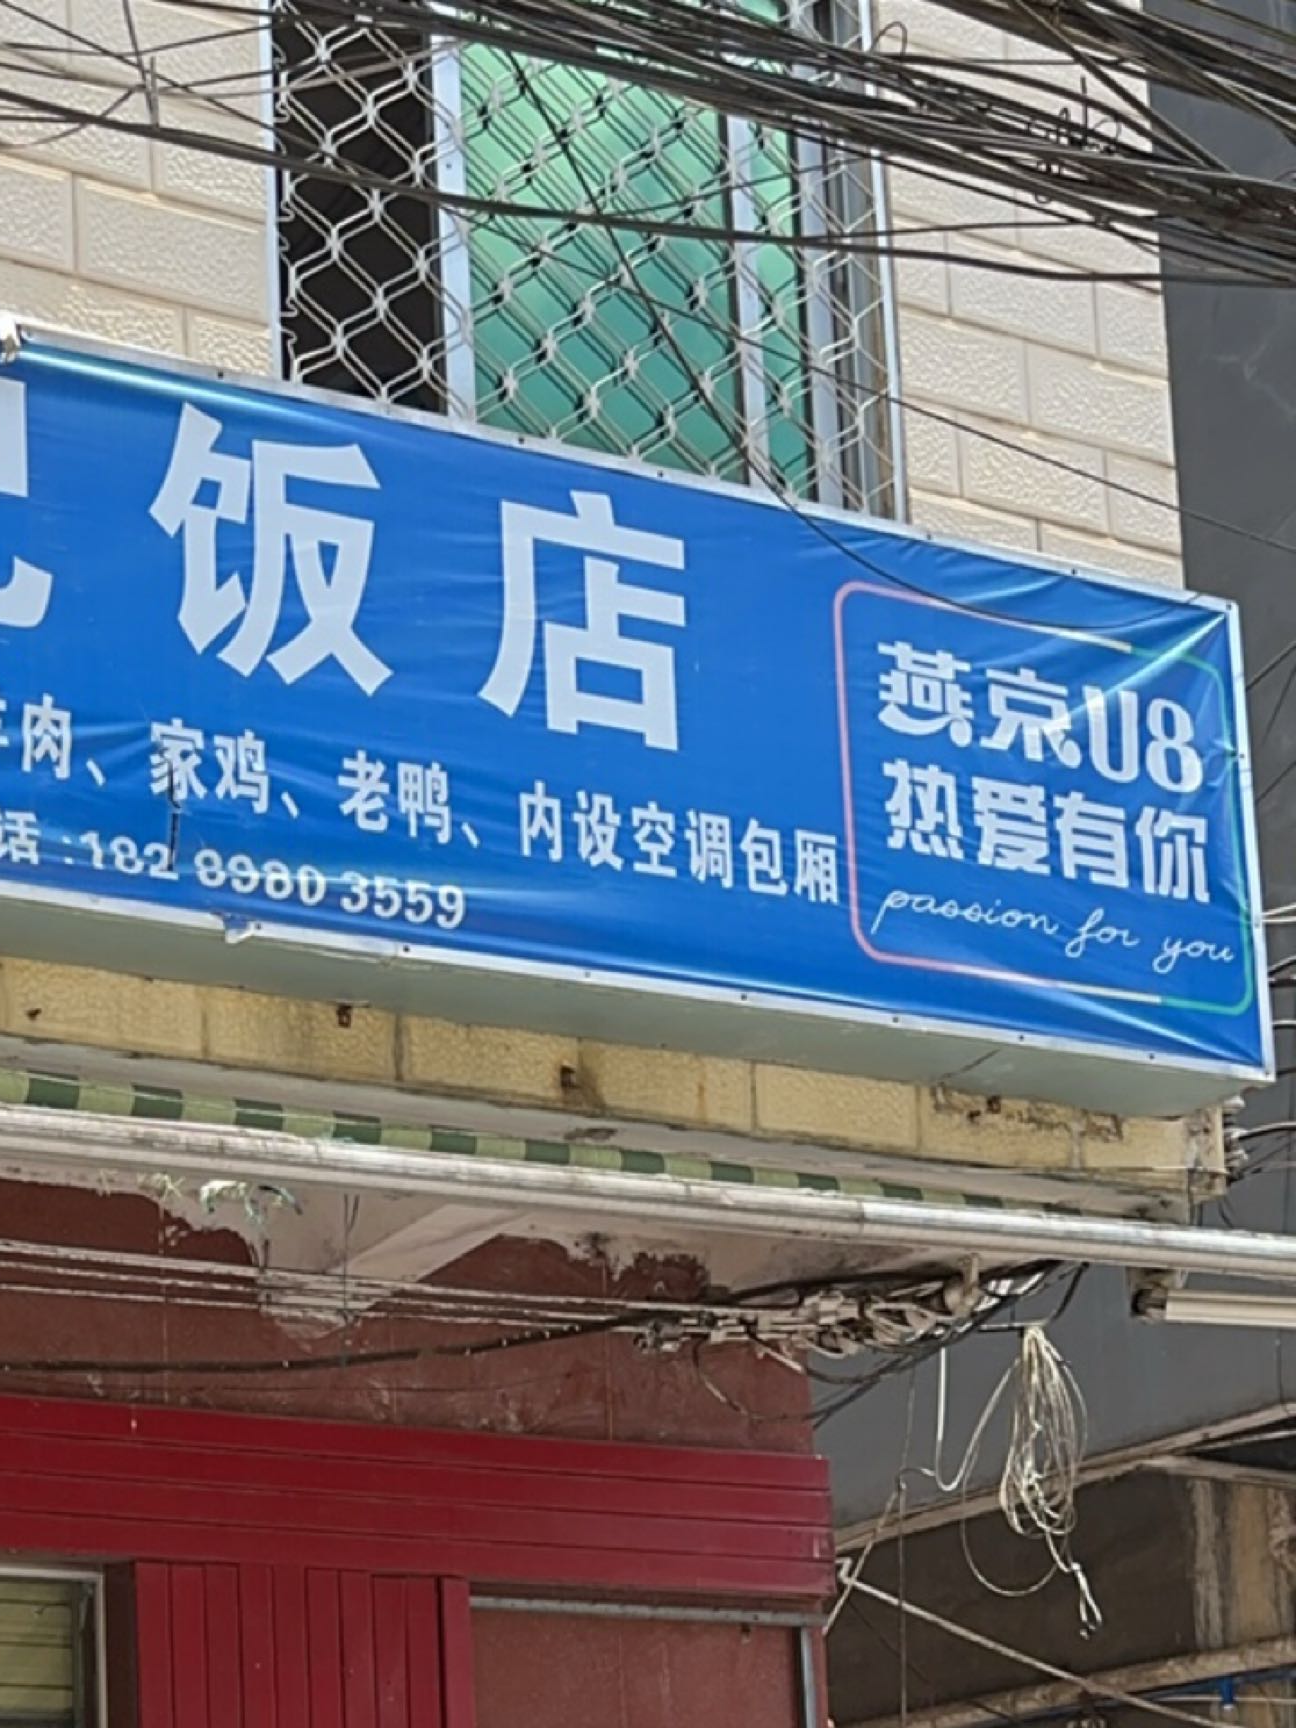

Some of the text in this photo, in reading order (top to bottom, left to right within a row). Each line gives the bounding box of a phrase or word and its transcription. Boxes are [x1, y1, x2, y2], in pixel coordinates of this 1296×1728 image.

[877, 641, 1204, 793] 燕京U8
[194, 848, 327, 907] 8980
[341, 868, 466, 930] 3559
[882, 758, 1210, 904] 热爱有你
[871, 889, 1235, 975] passion for you
